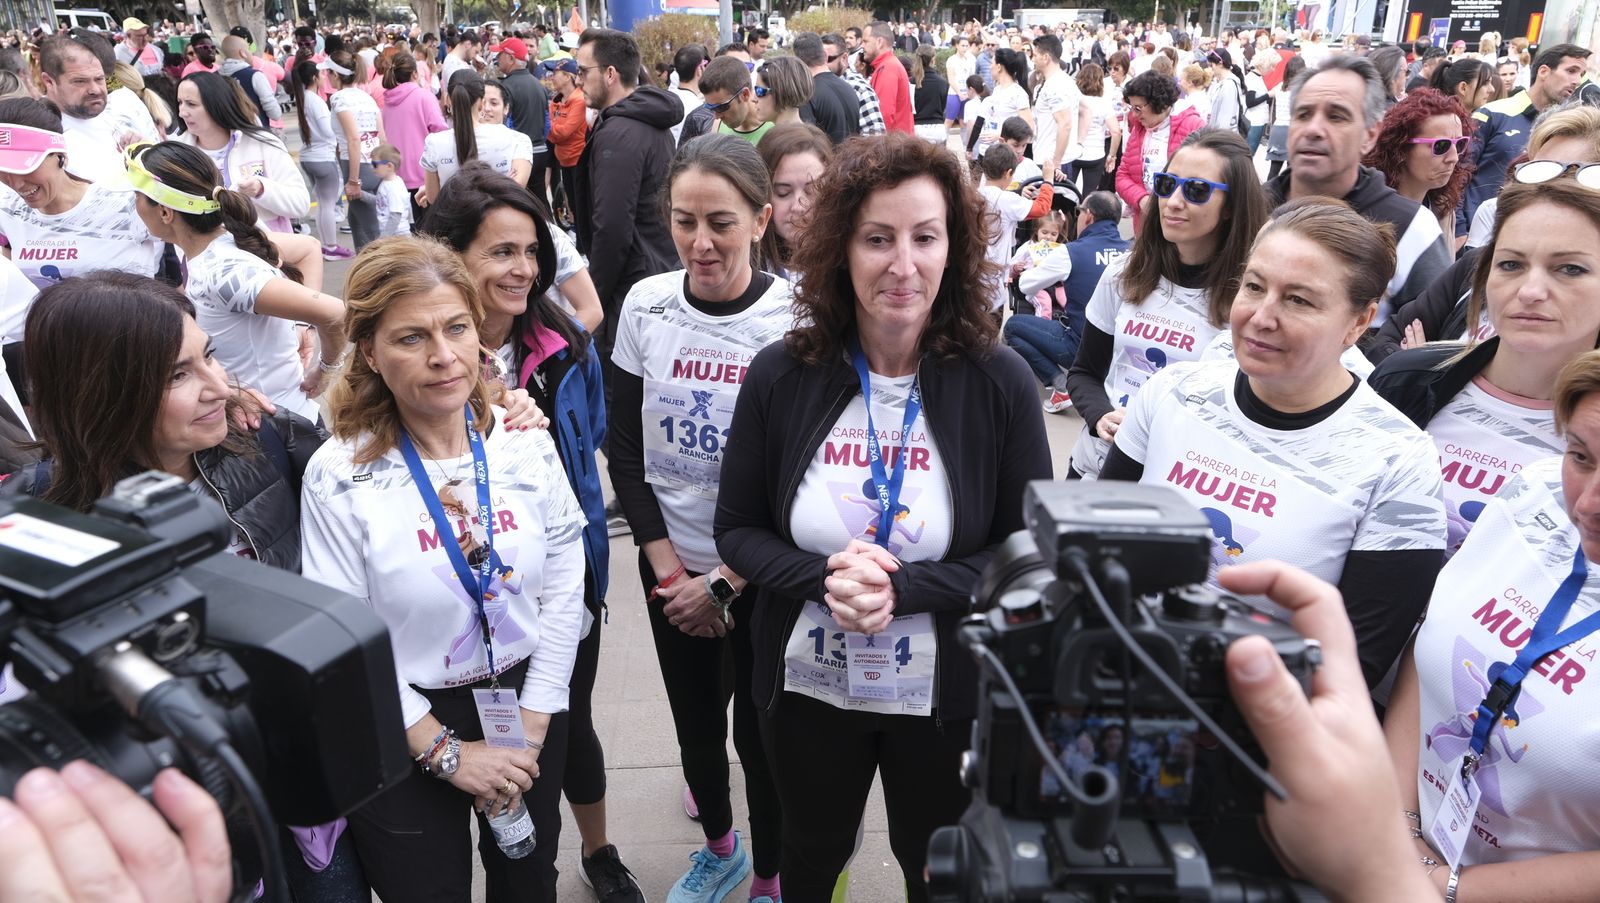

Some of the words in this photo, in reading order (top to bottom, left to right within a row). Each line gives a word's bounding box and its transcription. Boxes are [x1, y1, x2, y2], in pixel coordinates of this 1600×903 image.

[19, 248, 78, 260] MUJER
[1135, 311, 1171, 325] CARRERA
[1172, 321, 1184, 330] DE
[1123, 320, 1195, 352] MUJER
[680, 347, 722, 359] CARRERA
[725, 352, 739, 361] DE
[741, 354, 754, 362] LA
[1125, 377, 1141, 388] MUJER
[659, 396, 686, 407] MUJER
[911, 432, 926, 442] LA
[679, 447, 719, 462] ARANCHA
[870, 436, 879, 462] NEXA
[1444, 444, 1508, 470] CARRERA
[477, 461, 486, 485] NEXA
[1186, 450, 1238, 477] CARRERA
[1240, 471, 1259, 484] DE
[1260, 477, 1277, 489] LA
[1166, 460, 1277, 518] MUJER
[492, 496, 507, 507] LA
[878, 484, 890, 512] NEXA
[481, 505, 489, 529] NEXA
[1576, 643, 1597, 662] LA
[815, 656, 848, 670] MARIA
[460, 669, 471, 678] LA
[811, 670, 826, 679] CDX
[864, 671, 881, 680] VIP
[495, 725, 511, 733] VIP
[1423, 769, 1434, 784] ES
